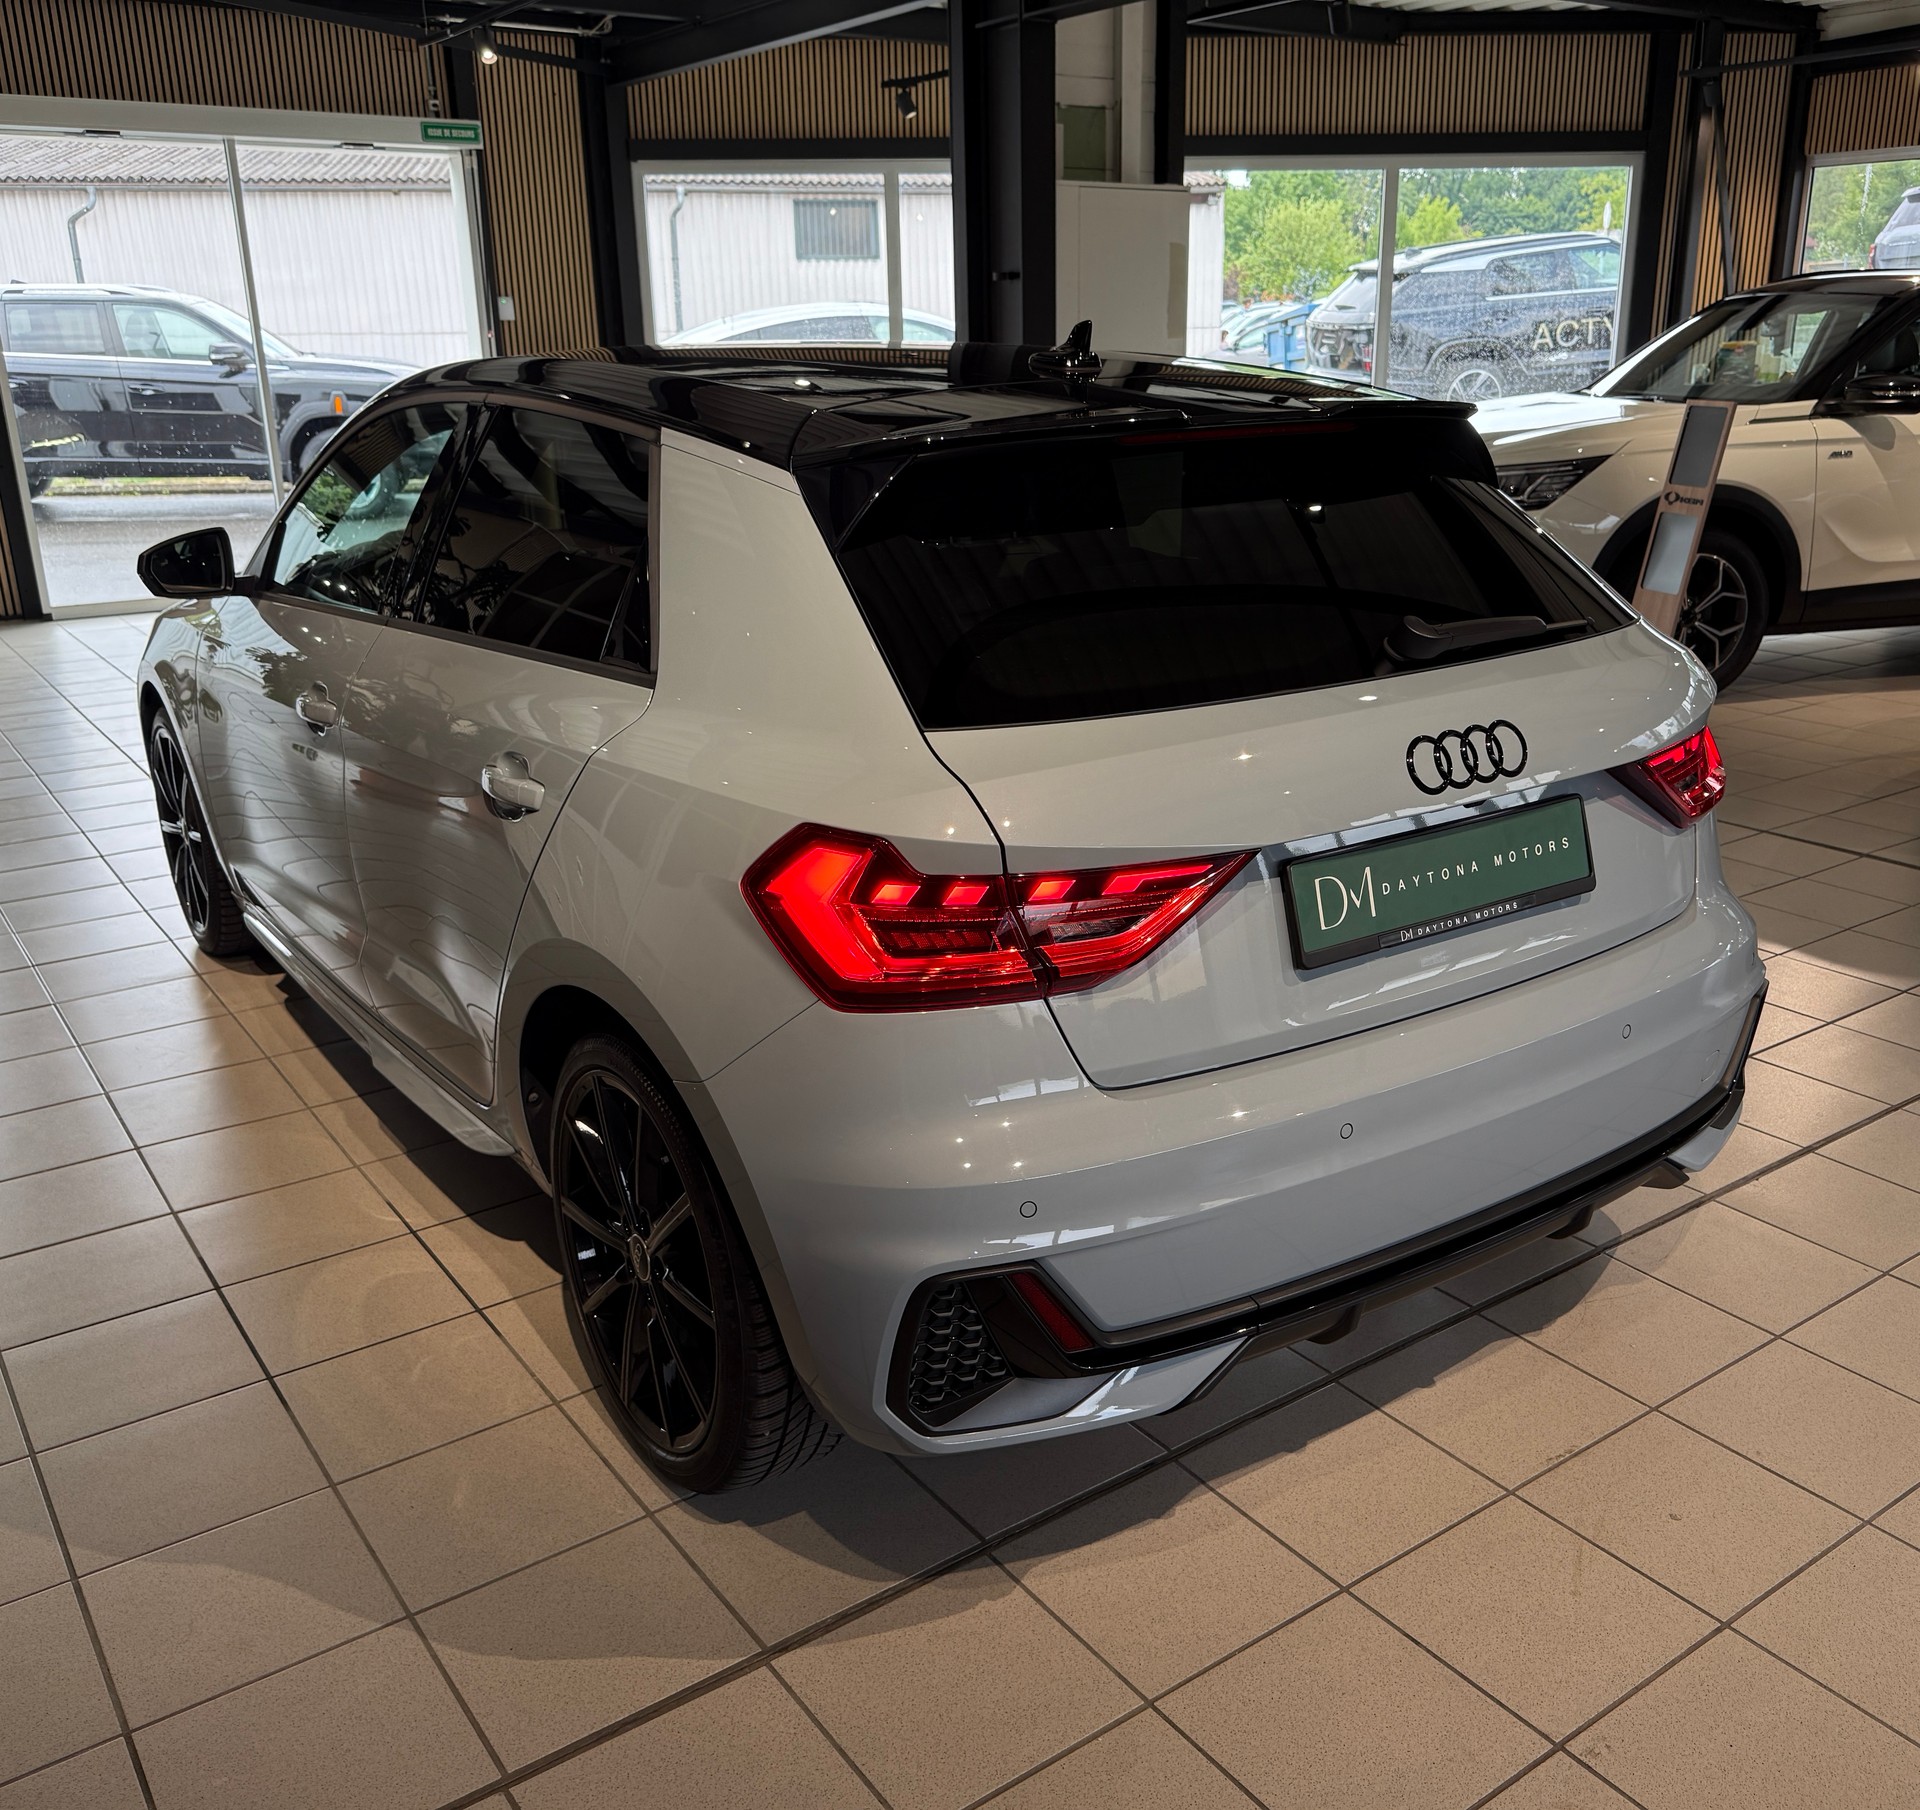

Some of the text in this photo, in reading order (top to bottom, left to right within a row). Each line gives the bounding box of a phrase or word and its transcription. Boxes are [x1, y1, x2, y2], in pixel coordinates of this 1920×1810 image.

[1382, 860, 1479, 895] DAYTONA
[1493, 837, 1569, 867] MOTORS
[1417, 916, 1468, 935] DAYTONA
[1475, 902, 1518, 920] MOTORS
